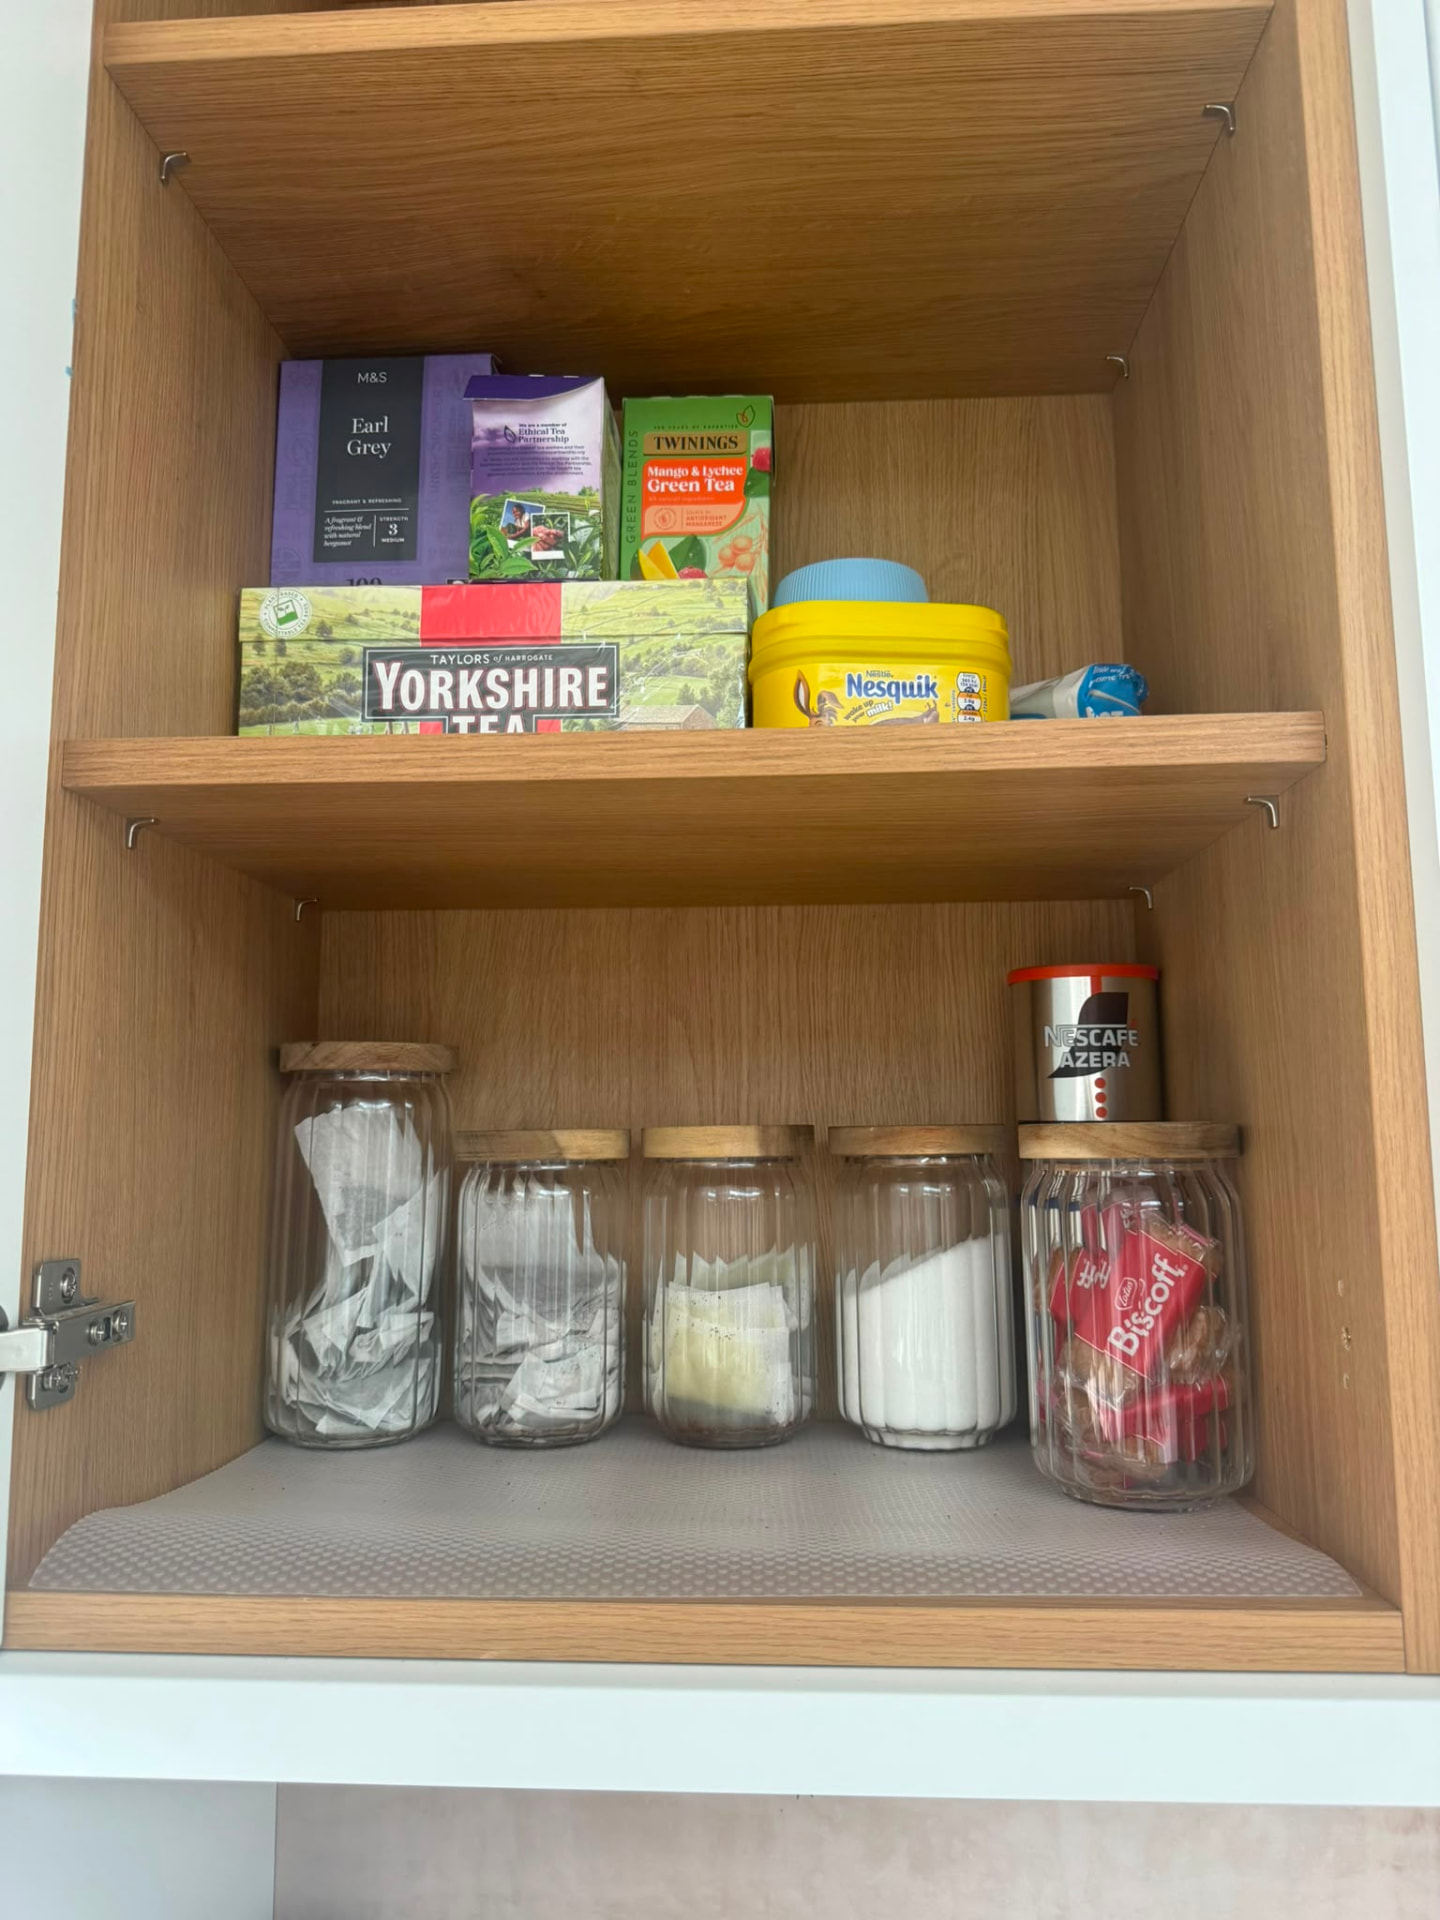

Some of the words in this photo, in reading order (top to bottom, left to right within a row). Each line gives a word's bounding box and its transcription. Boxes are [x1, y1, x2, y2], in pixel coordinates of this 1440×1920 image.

[357, 371, 388, 383] M&S
[351, 416, 389, 434] Earl
[518, 435, 570, 444] Partnership
[653, 435, 738, 450] TWININGS
[347, 439, 392, 458] Grey
[627, 430, 639, 486] BLENDS
[647, 466, 689, 478] Mango
[691, 465, 700, 477] &
[702, 465, 743, 478] Lychee
[647, 478, 700, 493] Green
[704, 478, 735, 492] Tea
[626, 494, 637, 543] GREEN
[388, 523, 398, 536] 3
[430, 654, 490, 665] TAYLORS
[493, 654, 503, 663] of
[505, 654, 553, 662] HARROGATE
[375, 662, 608, 711] YORKSHIRE
[846, 673, 938, 704] Nesquik
[866, 700, 893, 717] milk!
[1060, 1052, 1131, 1068] AZERA
[1108, 1252, 1186, 1357] Biscoff
